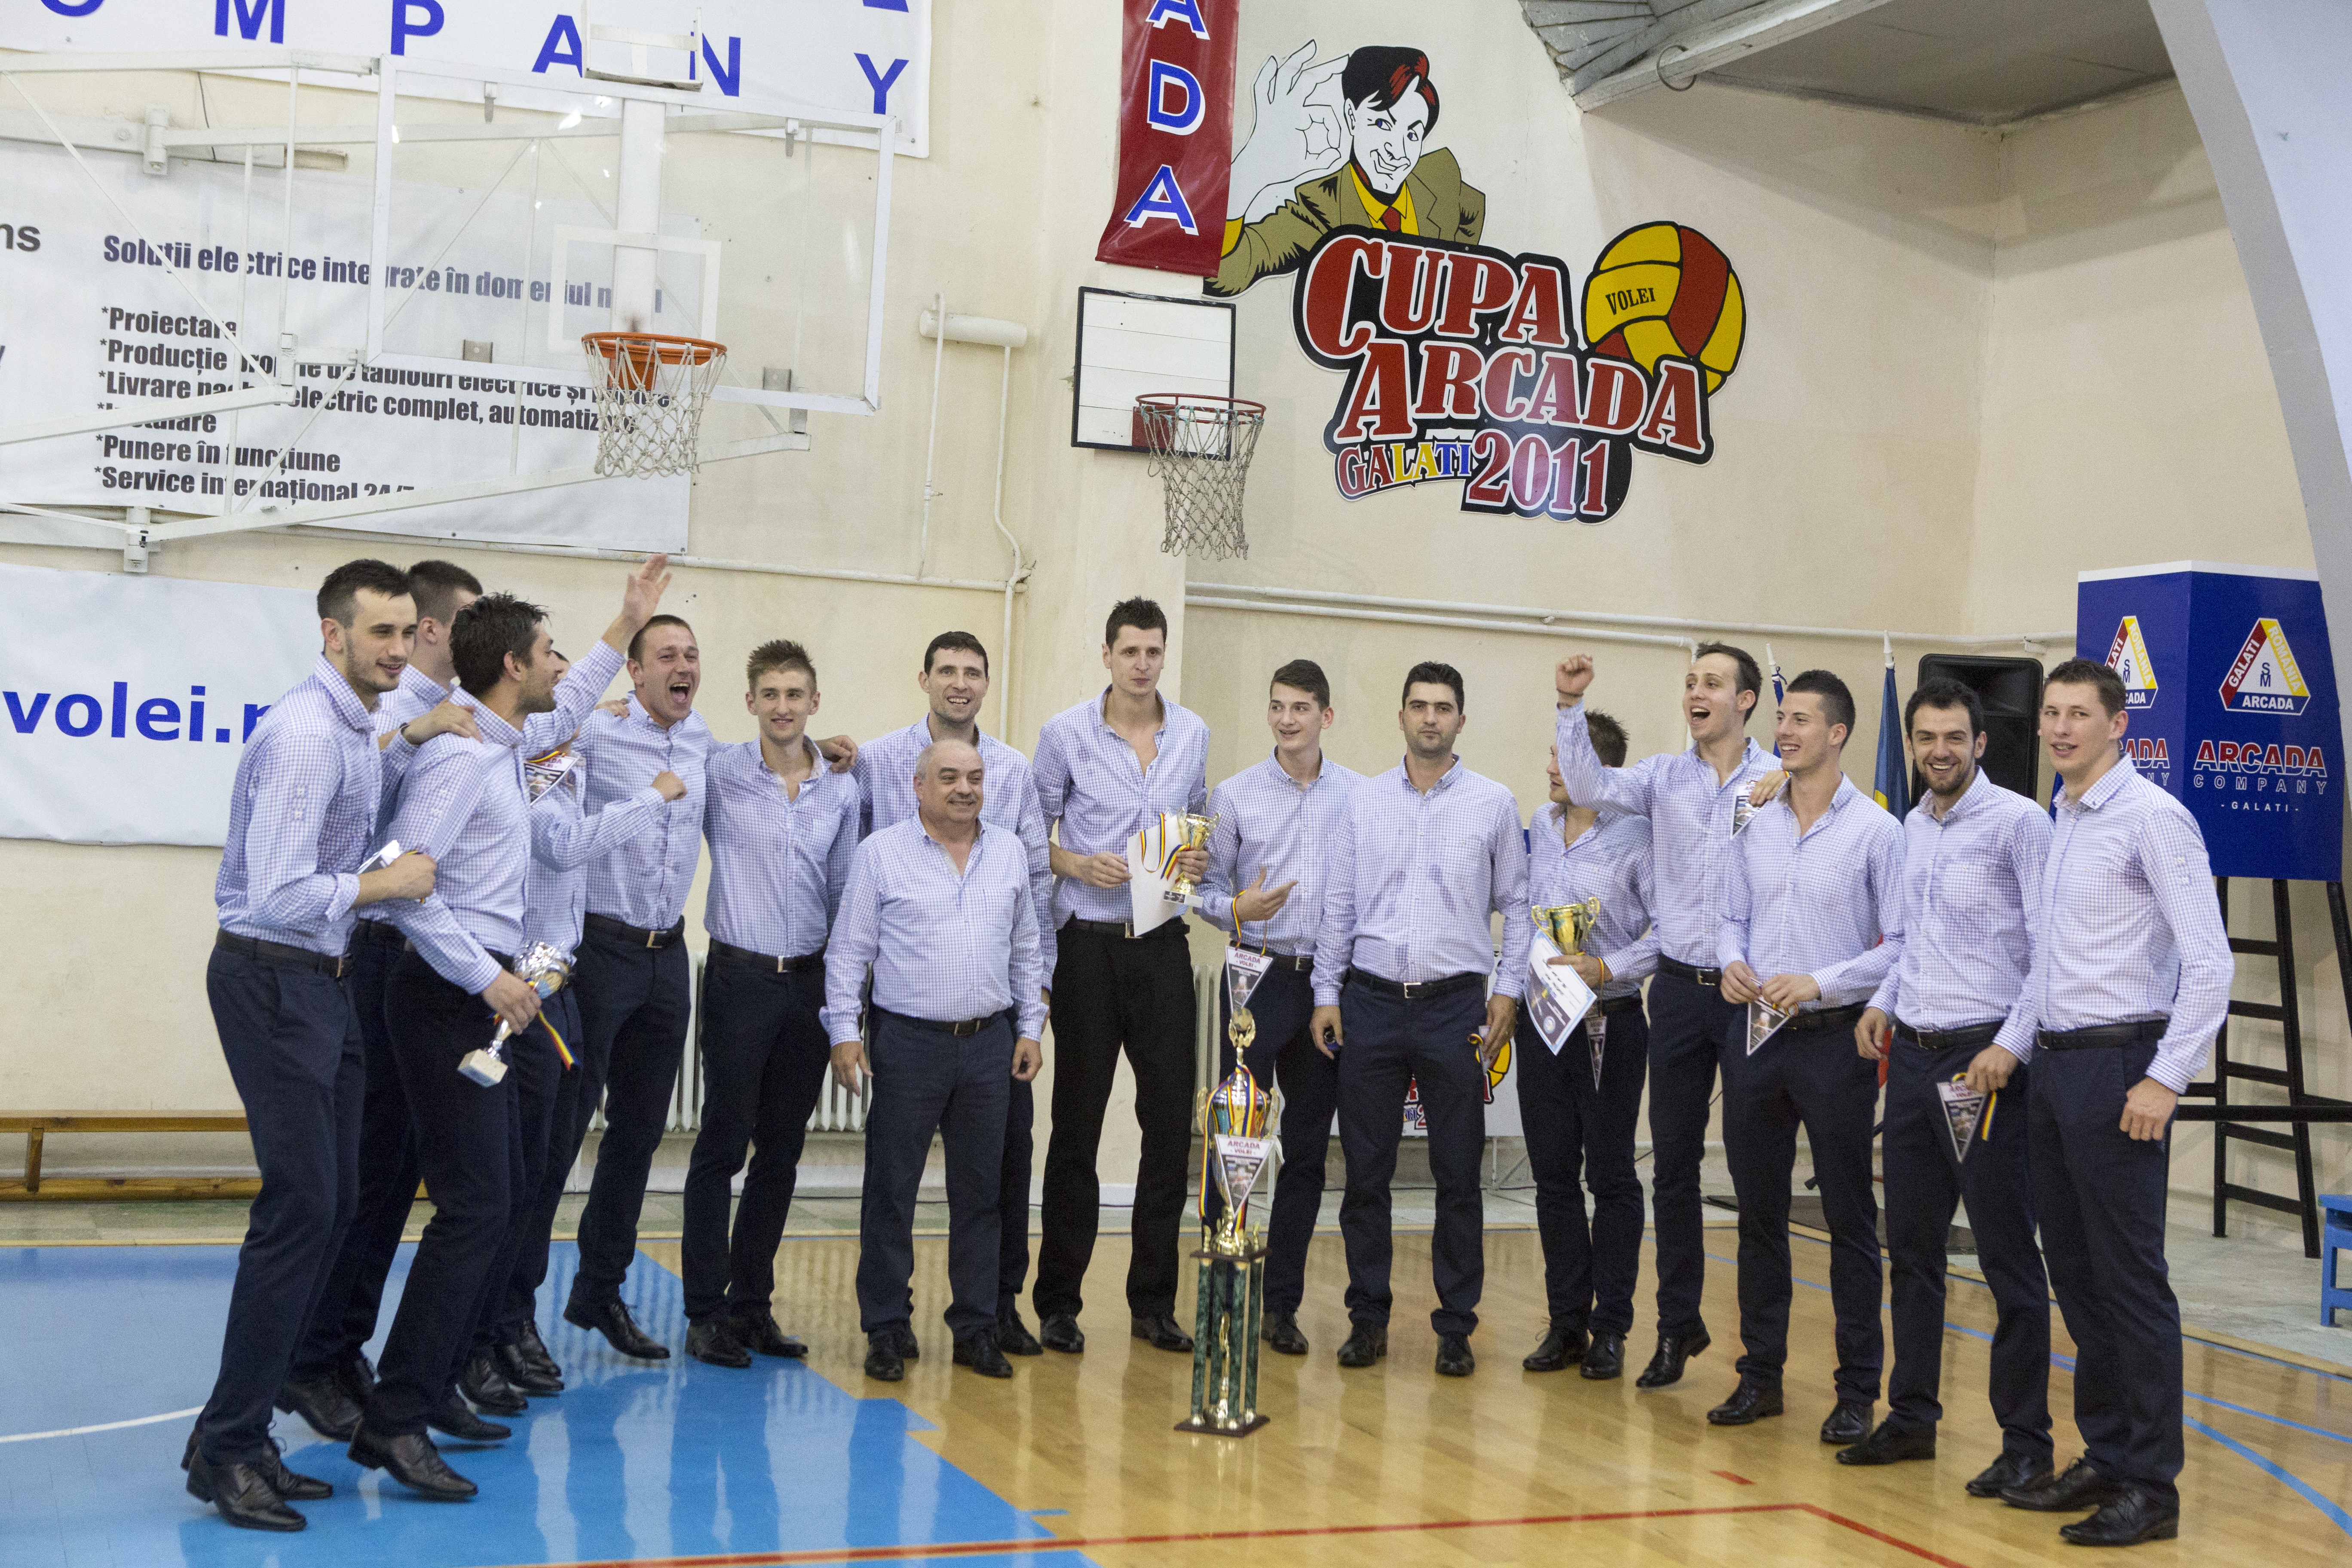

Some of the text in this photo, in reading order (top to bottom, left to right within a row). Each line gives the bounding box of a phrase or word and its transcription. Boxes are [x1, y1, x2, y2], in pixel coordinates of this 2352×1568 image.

[323, 257, 441, 291] interate
[445, 266, 470, 294] în
[1302, 234, 1570, 359] CUPA
[1605, 287, 1656, 316] VOLEI
[383, 398, 483, 424] complet,
[1334, 339, 1706, 454] ARCADA
[196, 441, 220, 464] în
[1338, 429, 1608, 517] GALATI 2011
[2228, 639, 2260, 688] GALATI
[2267, 625, 2303, 692] ROMANIA
[2242, 695, 2294, 710] ARCADA
[2193, 740, 2328, 778] ARCADA
[2193, 774, 2327, 795] COMPANY
[2231, 801, 2288, 812] GALATI
[1234, 952, 1261, 964] ARCADA
[1228, 1140, 1260, 1149] ARCADA
